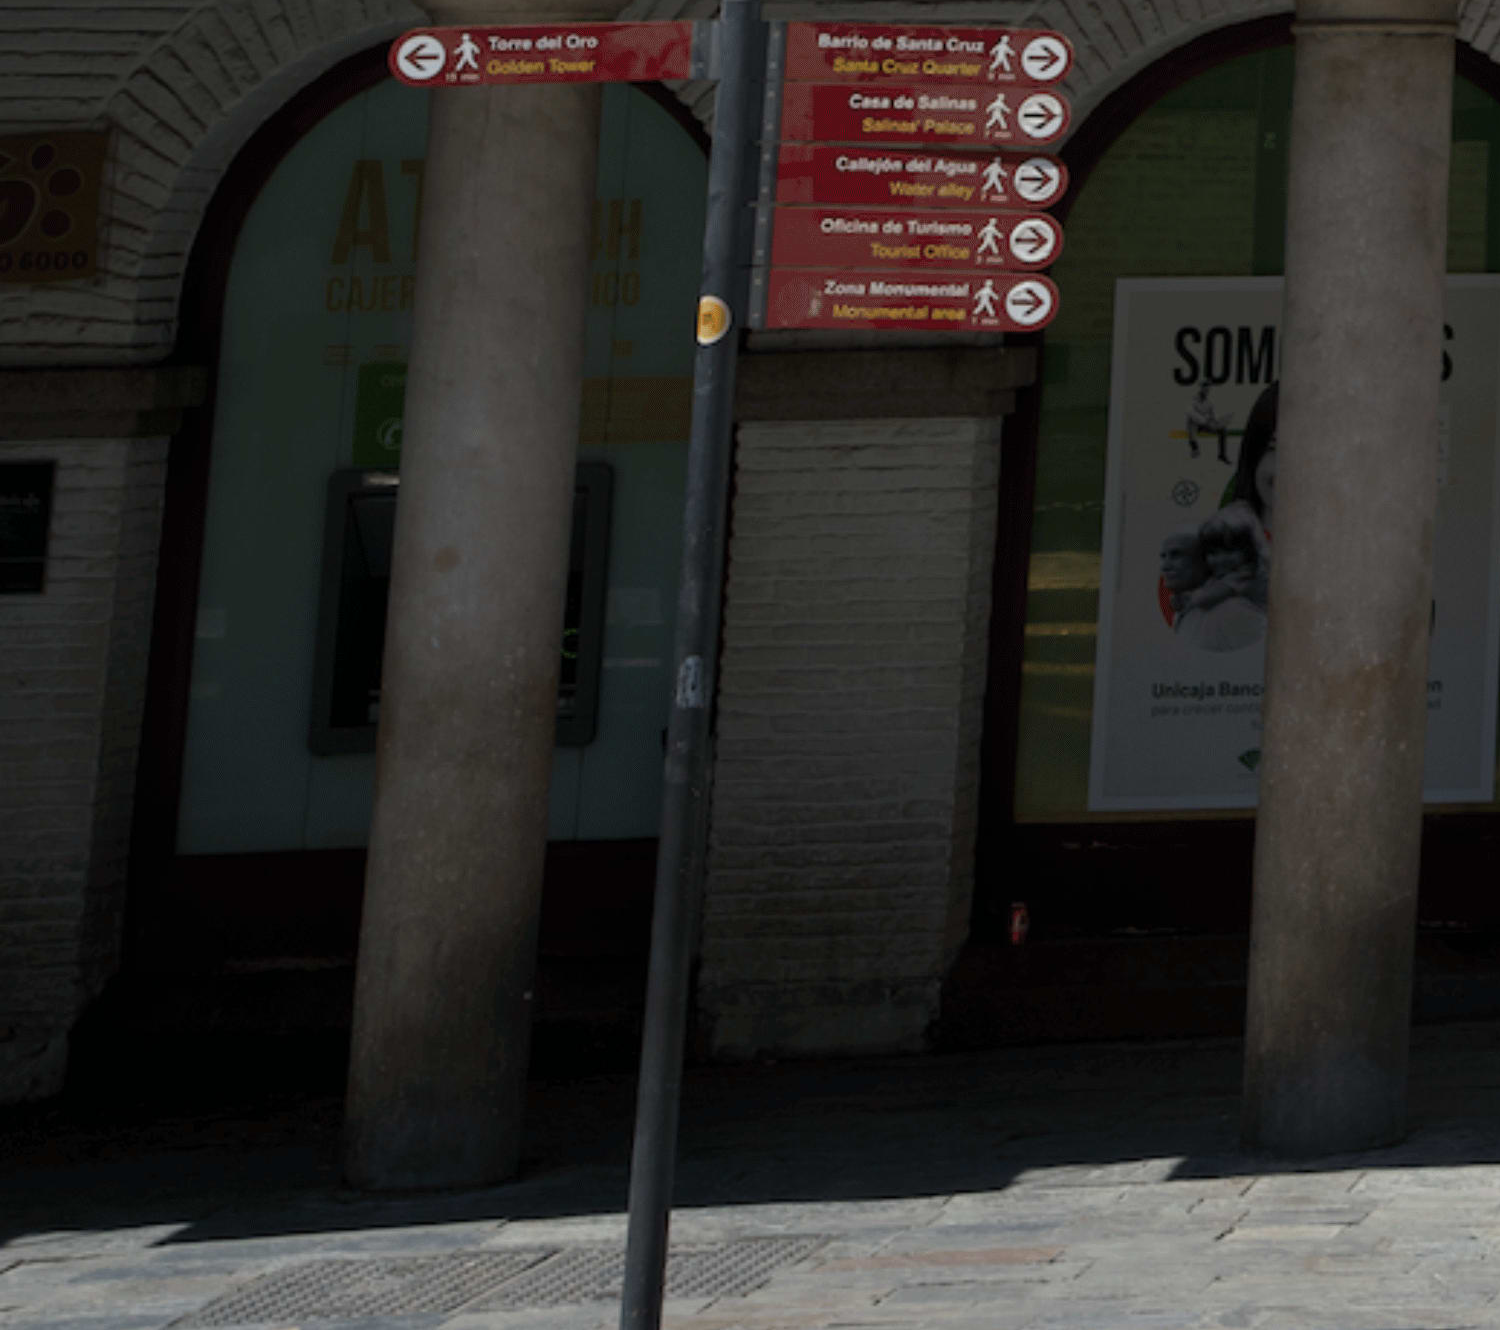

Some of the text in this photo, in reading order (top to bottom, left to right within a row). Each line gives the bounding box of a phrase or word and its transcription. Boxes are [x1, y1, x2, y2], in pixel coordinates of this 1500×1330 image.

[488, 33, 599, 51] Torre del Oro
[817, 34, 985, 54] Barrio de Santa Cruz
[486, 58, 597, 76] Golden Tower
[833, 57, 880, 73] Santa
[883, 59, 920, 75] Cruz
[922, 60, 982, 77] Quarter
[848, 94, 978, 112] Casa de Salinas
[924, 119, 976, 135] Palace
[835, 156, 978, 178] Callejón del Agua
[889, 181, 935, 197] Water
[937, 183, 975, 201] alley
[820, 218, 973, 237] Oficina de Turismo
[870, 243, 921, 259] Tourist
[923, 244, 971, 260] Office
[824, 281, 970, 298] Zona Monumental
[832, 305, 929, 320] Monumental
[931, 307, 968, 321] area
[1151, 682, 1215, 700] Unicaja
